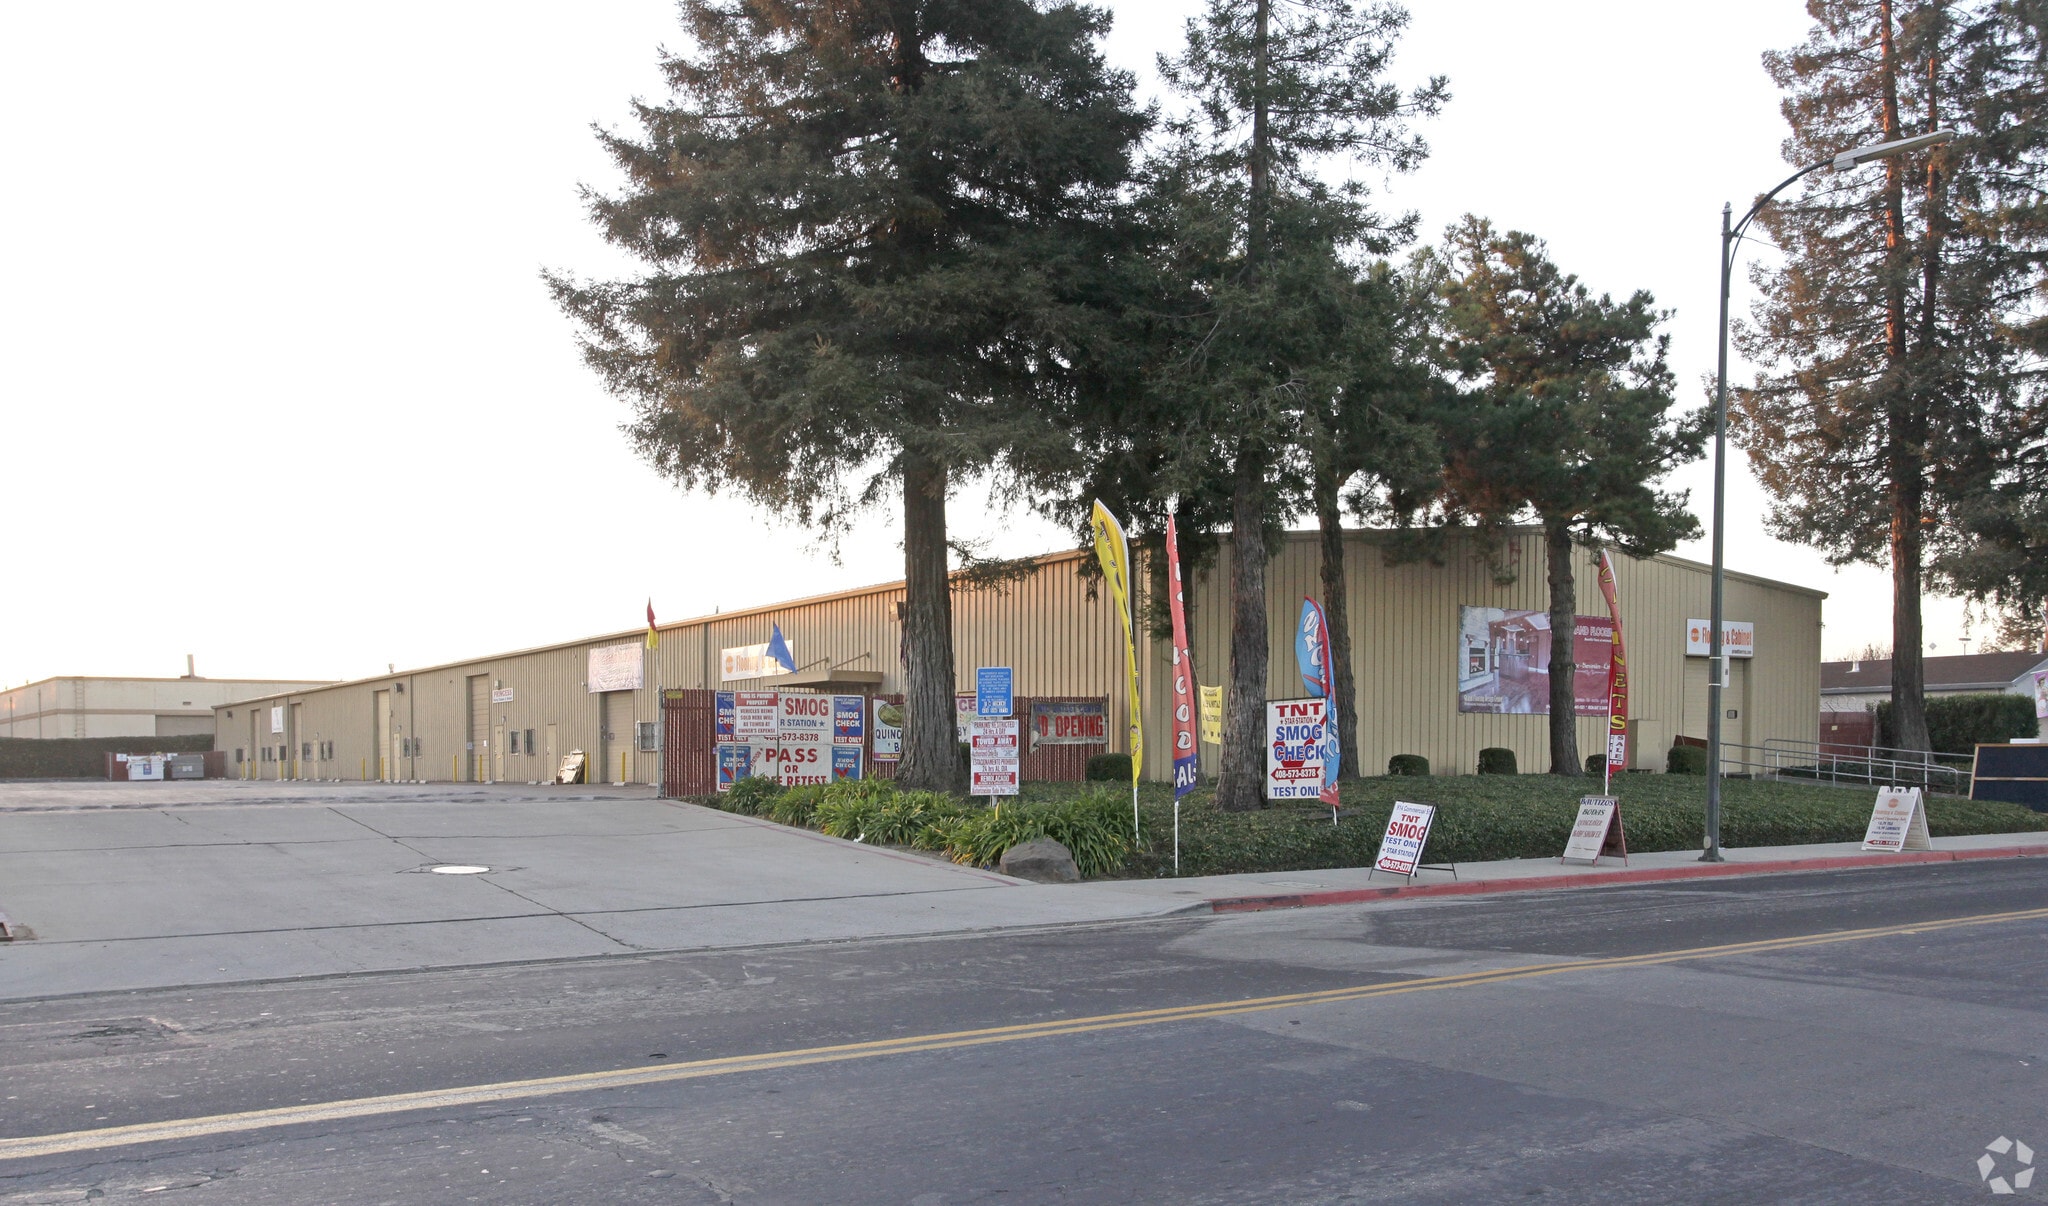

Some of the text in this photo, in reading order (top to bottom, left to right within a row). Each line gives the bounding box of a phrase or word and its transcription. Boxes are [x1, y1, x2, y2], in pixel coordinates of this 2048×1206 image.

[785, 697, 829, 717] SMOG
[1275, 702, 1324, 718] TNT
[836, 711, 859, 719] SMOG
[787, 719, 817, 727] STATION
[835, 720, 860, 728] CHECK
[1296, 717, 1313, 725] STATION
[1055, 714, 1104, 738] OPENING
[1275, 724, 1323, 741] SMOG
[976, 736, 1013, 745] TOWED AWAY
[1615, 735, 1624, 760] SALE
[765, 748, 818, 763] PASS
[1274, 745, 1326, 762] CHECK
[784, 765, 799, 774] OR
[1275, 769, 1317, 779] 408-573-8378
[1273, 786, 1321, 797] TEST ONL
[1580, 798, 1614, 806] BAUTIZOS
[1401, 814, 1420, 823] TNT
[1388, 821, 1427, 841] SMOG
[1385, 837, 1402, 845] TEST
[1397, 849, 1415, 858] STATION
